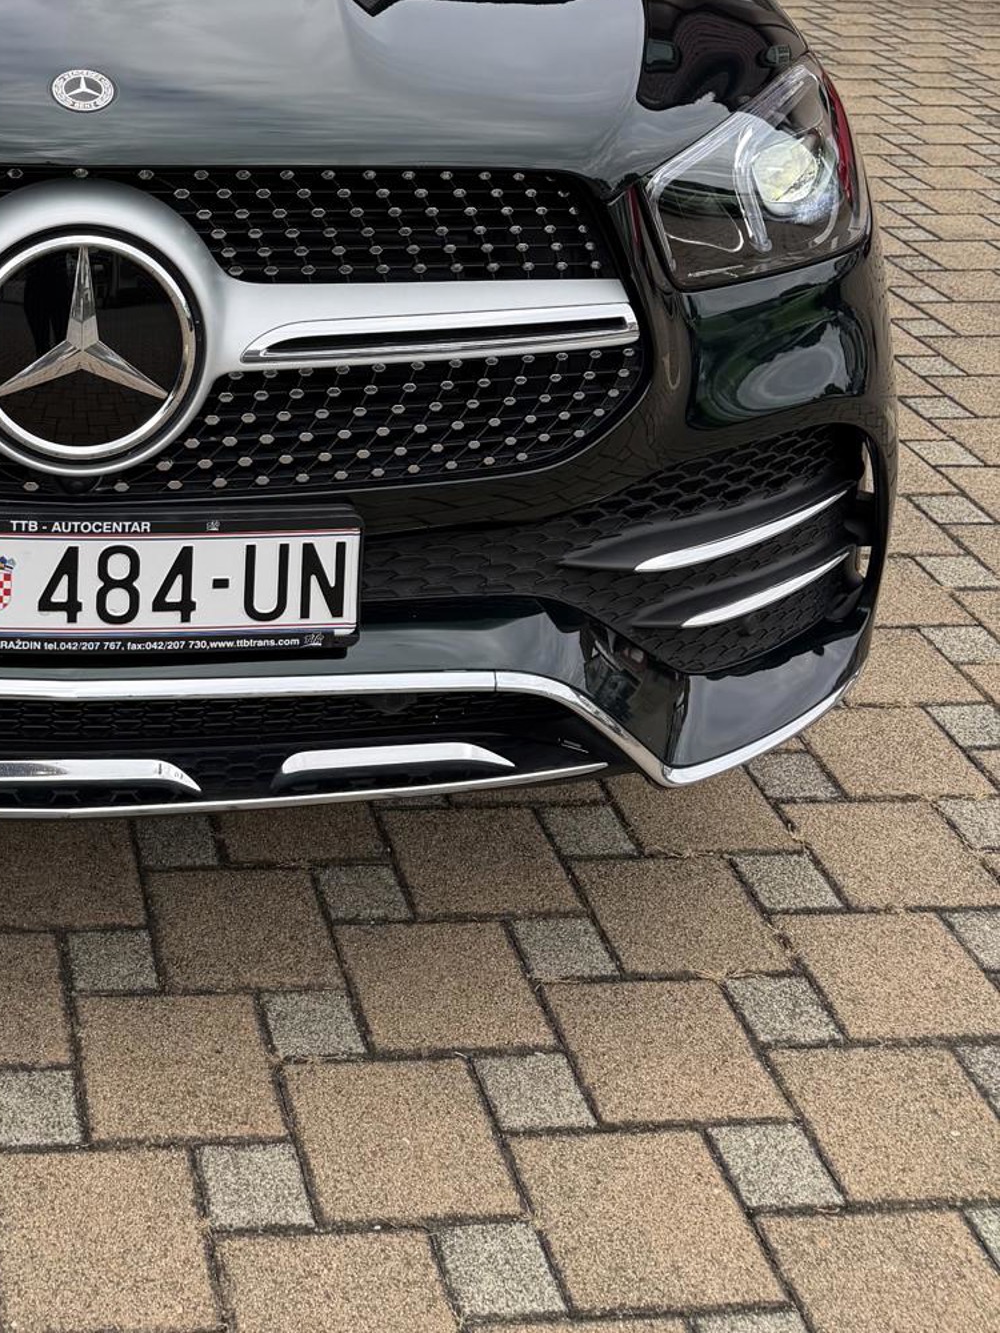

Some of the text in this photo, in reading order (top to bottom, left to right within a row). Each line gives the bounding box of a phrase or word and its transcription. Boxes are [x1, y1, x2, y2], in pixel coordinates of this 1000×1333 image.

[10, 520, 38, 532] TTB
[51, 521, 151, 533] AUTOCENTAR
[37, 541, 347, 625] 484-UN
